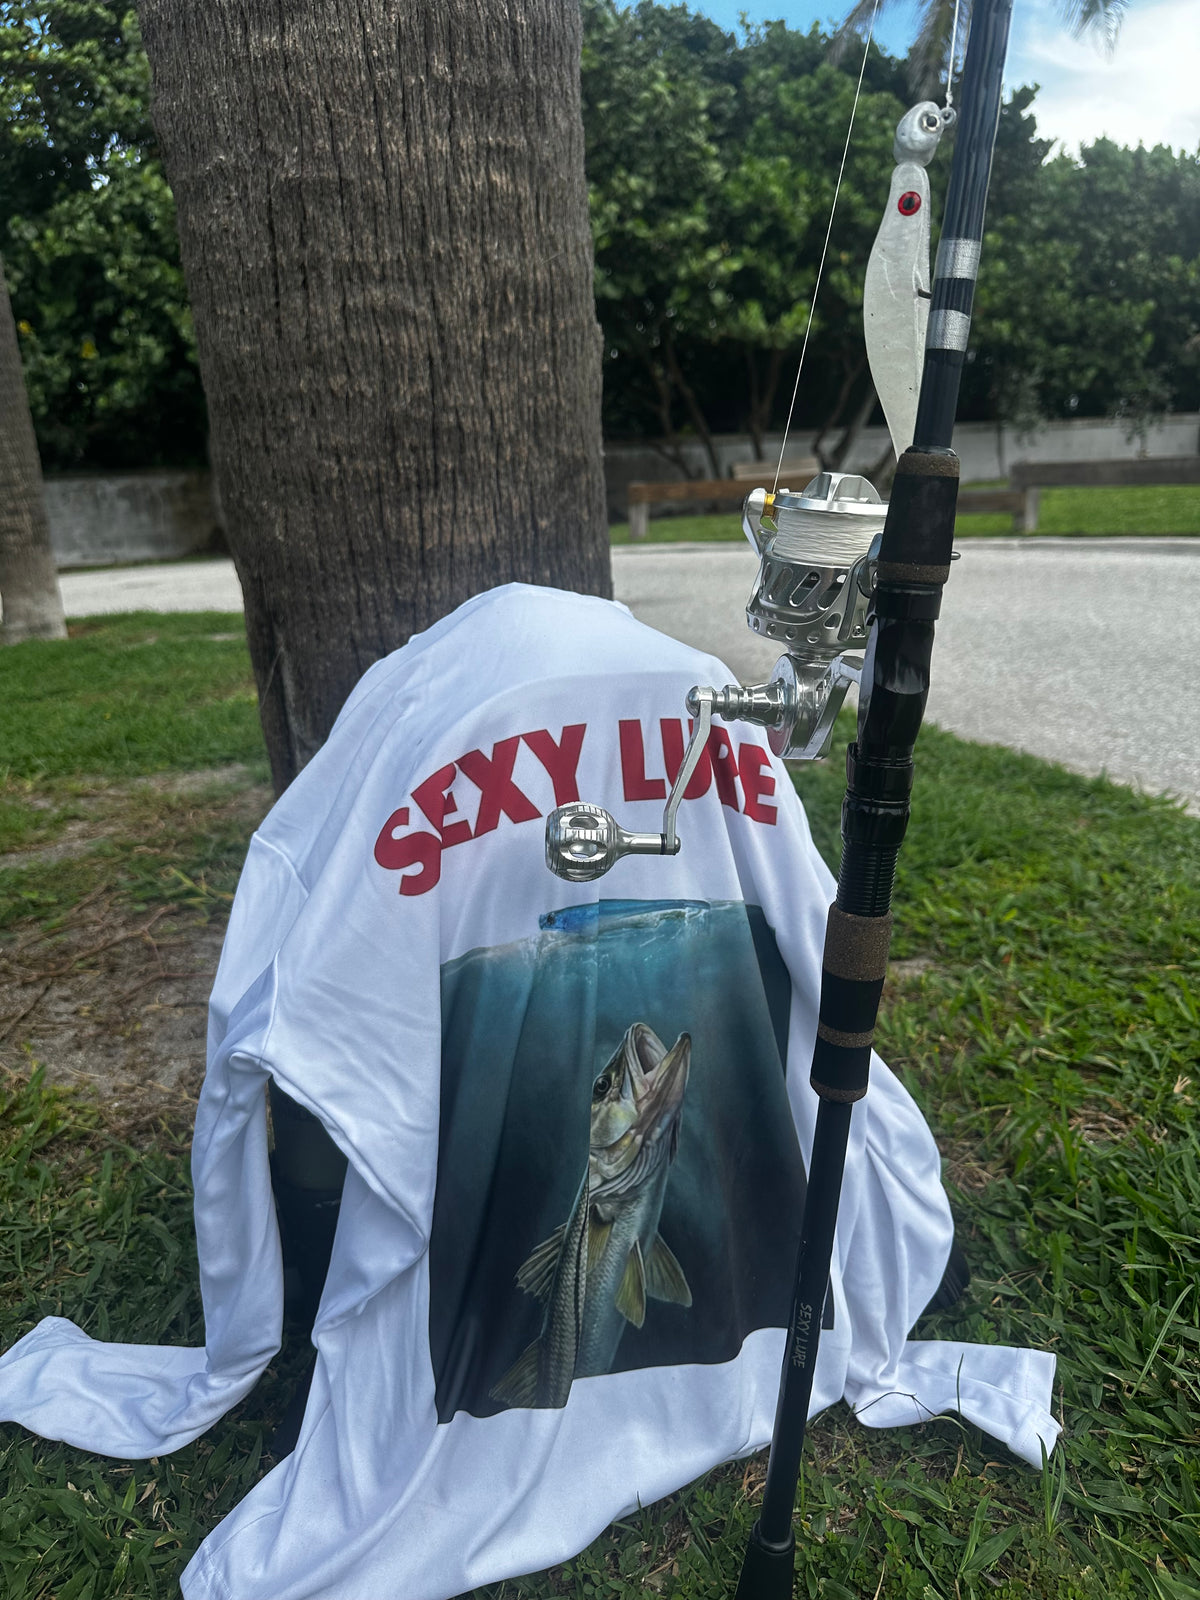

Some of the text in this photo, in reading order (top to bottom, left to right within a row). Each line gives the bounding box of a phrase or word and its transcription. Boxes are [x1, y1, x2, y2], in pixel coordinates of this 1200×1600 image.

[374, 718, 778, 896] SEXY LURE
[791, 1302, 813, 1368] SEXY LURE
